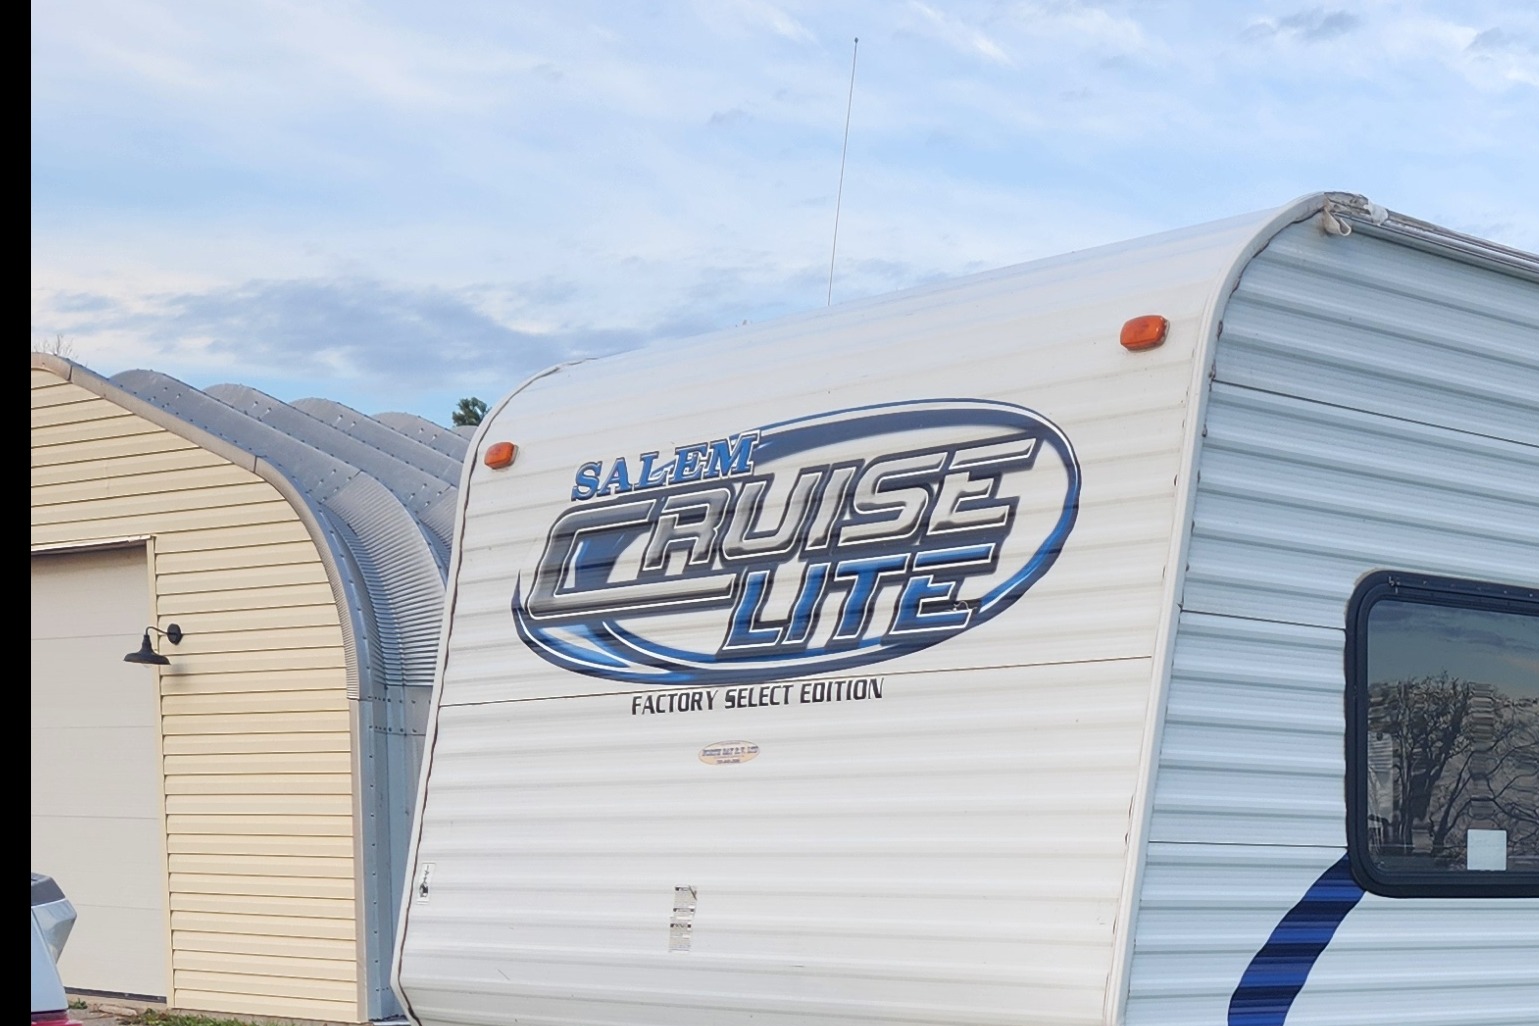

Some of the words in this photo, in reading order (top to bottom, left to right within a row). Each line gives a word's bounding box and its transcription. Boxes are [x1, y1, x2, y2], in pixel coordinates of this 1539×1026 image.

[569, 430, 762, 502] SALEM
[527, 436, 1046, 620] CRUISE
[719, 540, 1001, 656] LITE
[631, 689, 718, 716] FACTORY
[724, 684, 794, 710] SELECT
[800, 676, 885, 704] EDITION
